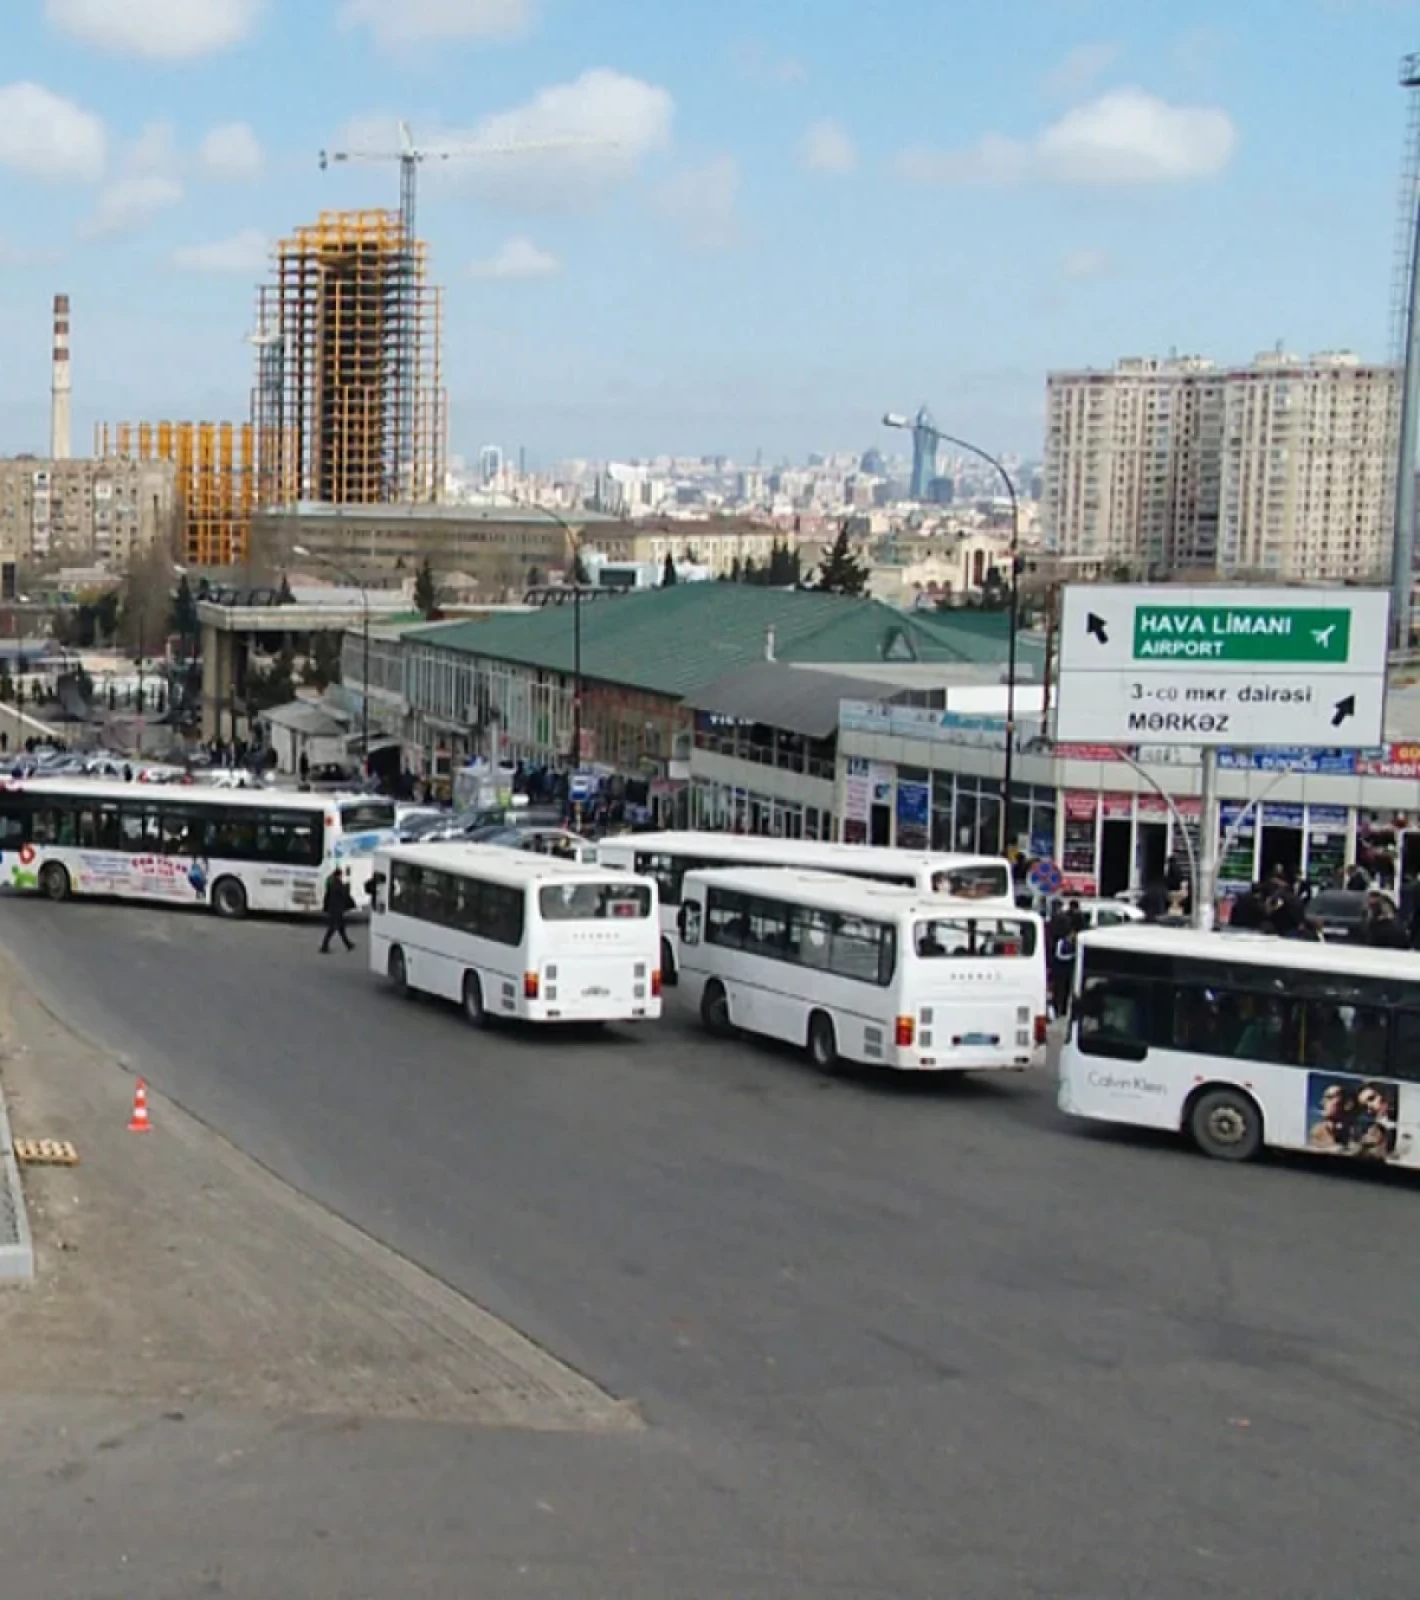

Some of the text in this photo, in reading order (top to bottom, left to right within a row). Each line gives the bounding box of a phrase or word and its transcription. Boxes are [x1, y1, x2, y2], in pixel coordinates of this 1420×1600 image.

[1141, 612, 1291, 635] HAVA LİMANI
[1141, 639, 1224, 656] AIRPORT
[1128, 712, 1229, 733] MƏRKƏZ
